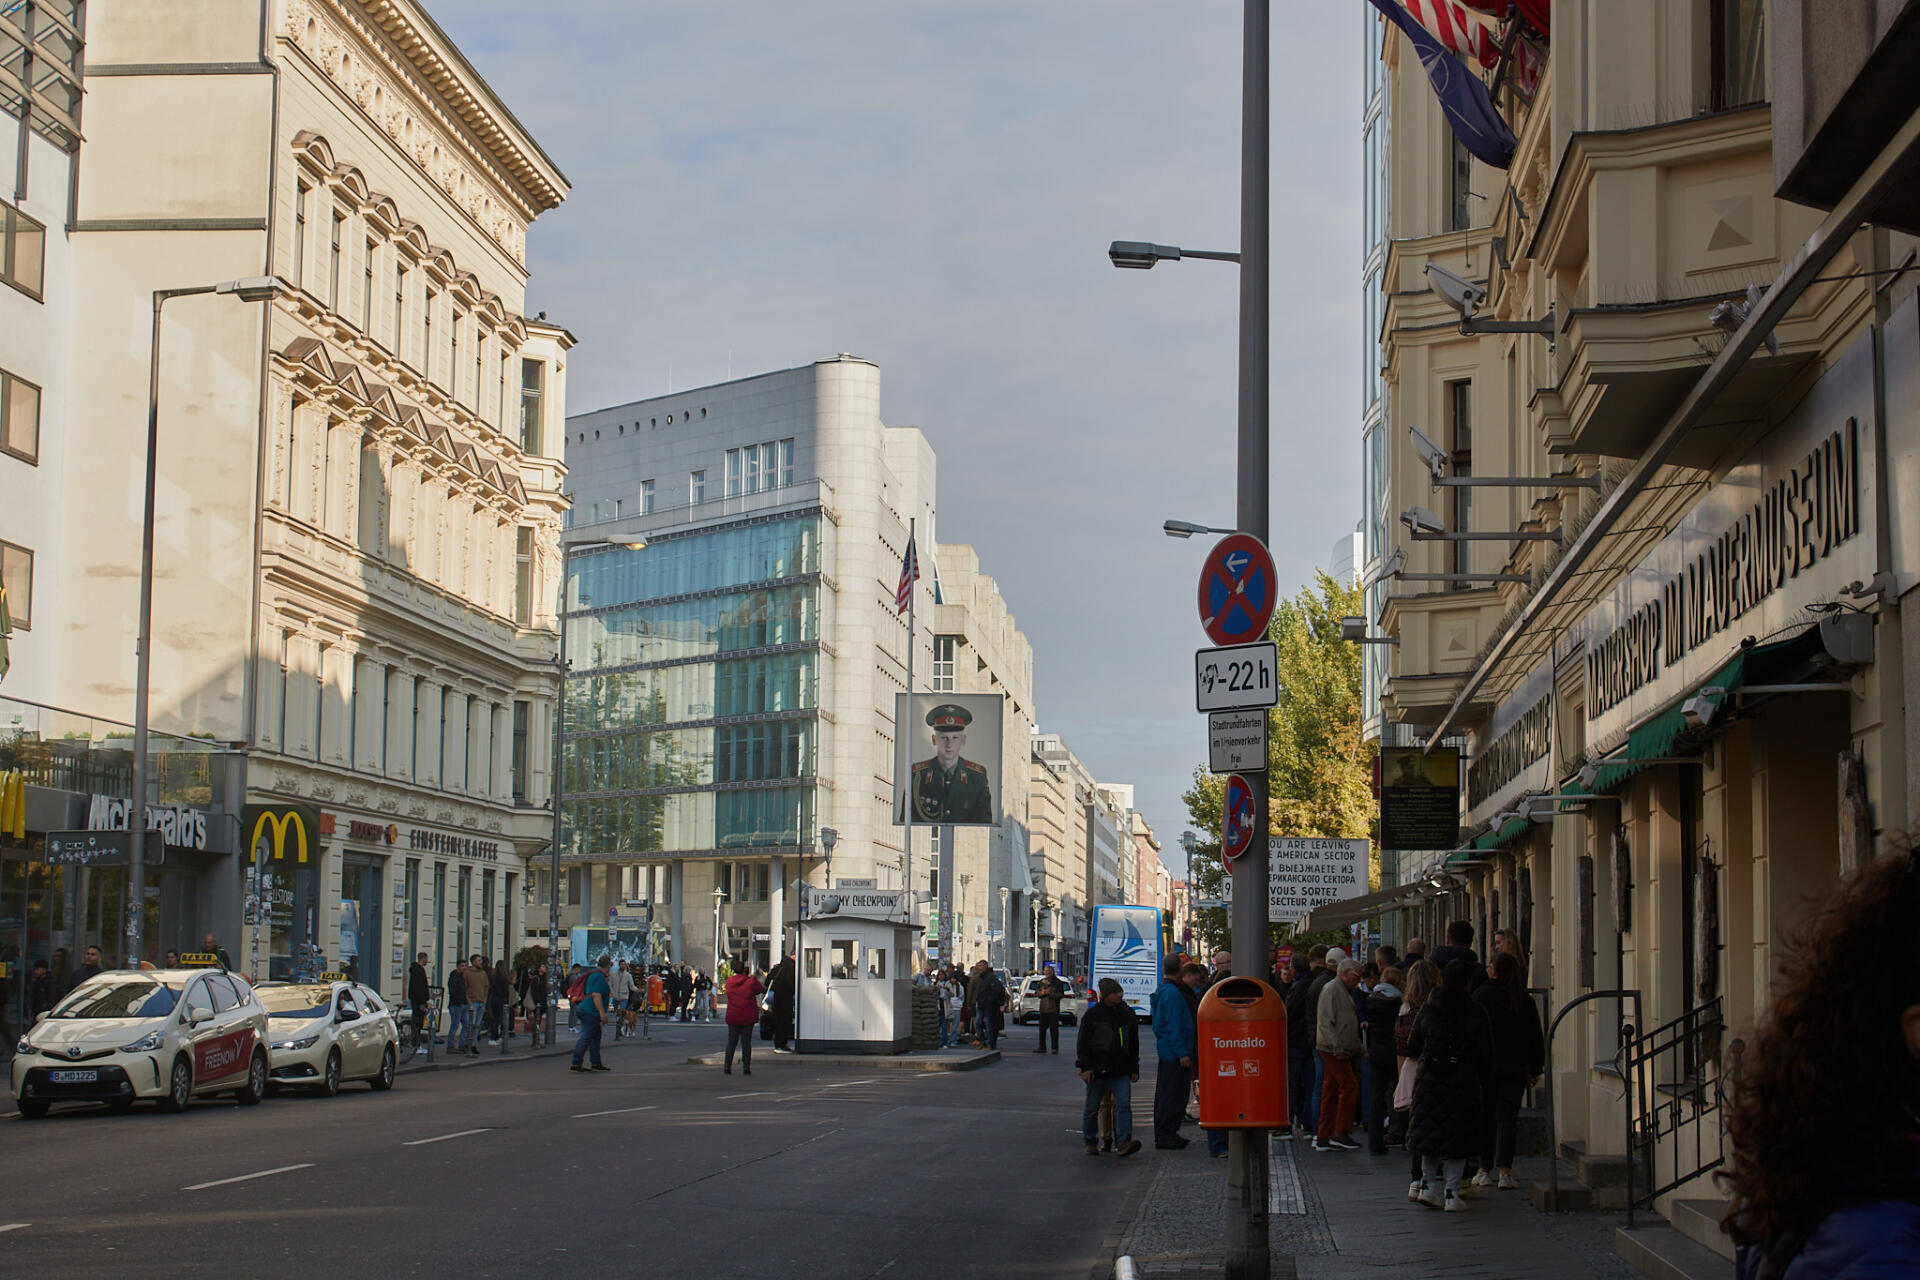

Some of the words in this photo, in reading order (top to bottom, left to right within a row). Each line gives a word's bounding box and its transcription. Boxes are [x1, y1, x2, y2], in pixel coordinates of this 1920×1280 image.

[1586, 598, 1661, 722] MAUERSHOP
[1664, 571, 1684, 668] IM
[1686, 415, 1859, 652] MAUERMUSEUM
[1259, 659, 1269, 689] h
[1212, 718, 1262, 731] Stadtrundfahrten
[1213, 737, 1220, 748] im
[1231, 752, 1242, 763] frei
[409, 829, 458, 856] EINSTEIN
[464, 838, 499, 861] KAFFEE
[1269, 840, 1282, 849] OU
[1287, 840, 1306, 849] ARE
[1311, 841, 1351, 850] LEAVING
[1277, 851, 1320, 860] AMERICAN
[1324, 851, 1356, 861] SECTOR
[1279, 864, 1336, 873] ВЫЕЗЖАЕТЕ
[1341, 865, 1354, 874] ИЗ
[1268, 874, 1320, 883] ЕРИКАНСКОГО
[1323, 875, 1356, 884] СЕКТОРА
[1270, 886, 1296, 896] VOUS
[1301, 886, 1338, 897] SORTEZ
[852, 895, 899, 907] CHECKPOINT
[1270, 897, 1308, 906] SECTEUR
[1309, 898, 1346, 907] AMERI
[185, 953, 210, 962] TAXI
[323, 972, 342, 981] TAXI
[1212, 1037, 1266, 1048] Tonnaldo
